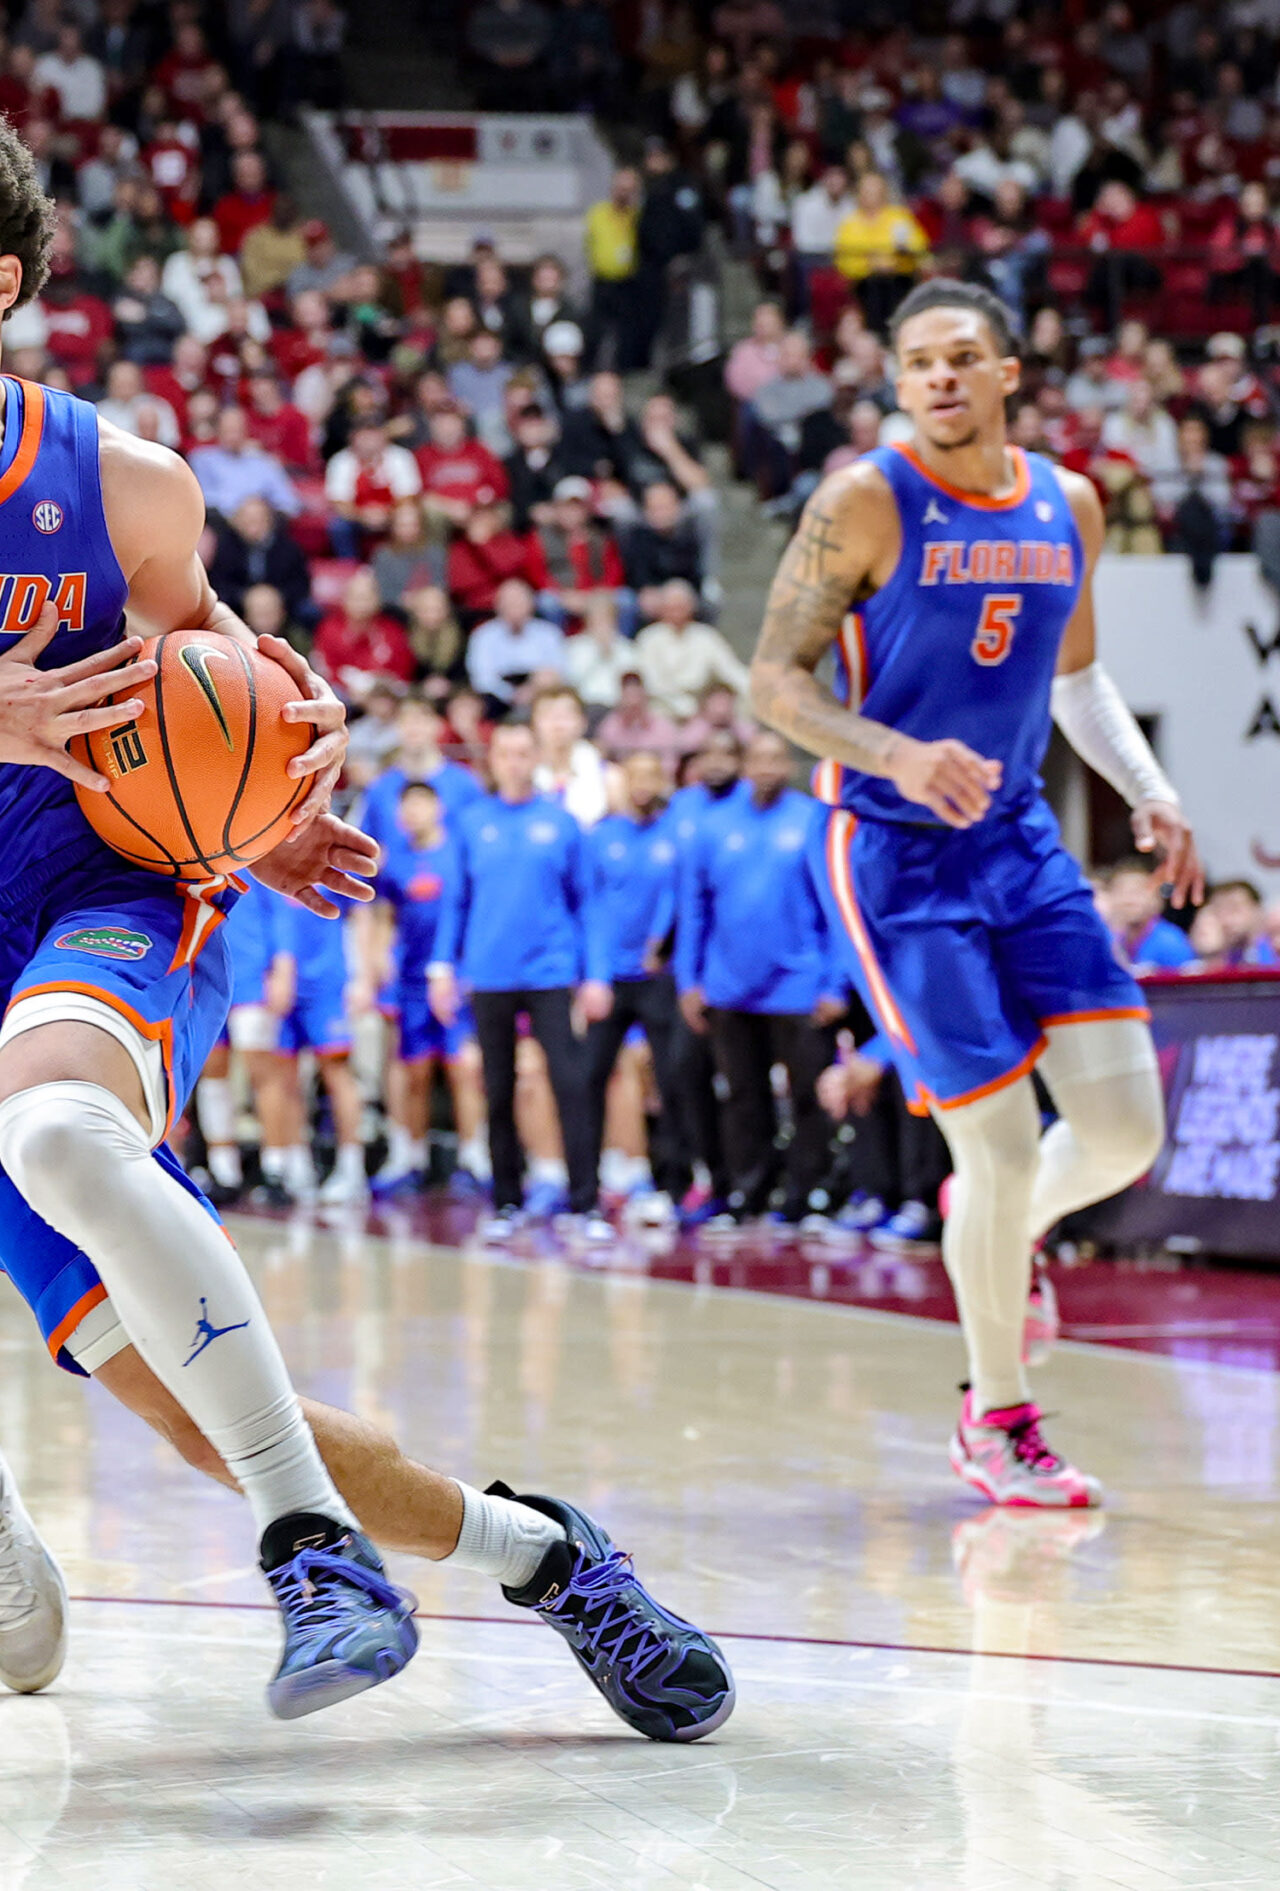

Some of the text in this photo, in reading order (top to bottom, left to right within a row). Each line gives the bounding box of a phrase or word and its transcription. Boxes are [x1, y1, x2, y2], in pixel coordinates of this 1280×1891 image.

[35, 503, 61, 531] SEC
[918, 540, 1074, 587] FLORIDA
[972, 593, 1023, 667] 5
